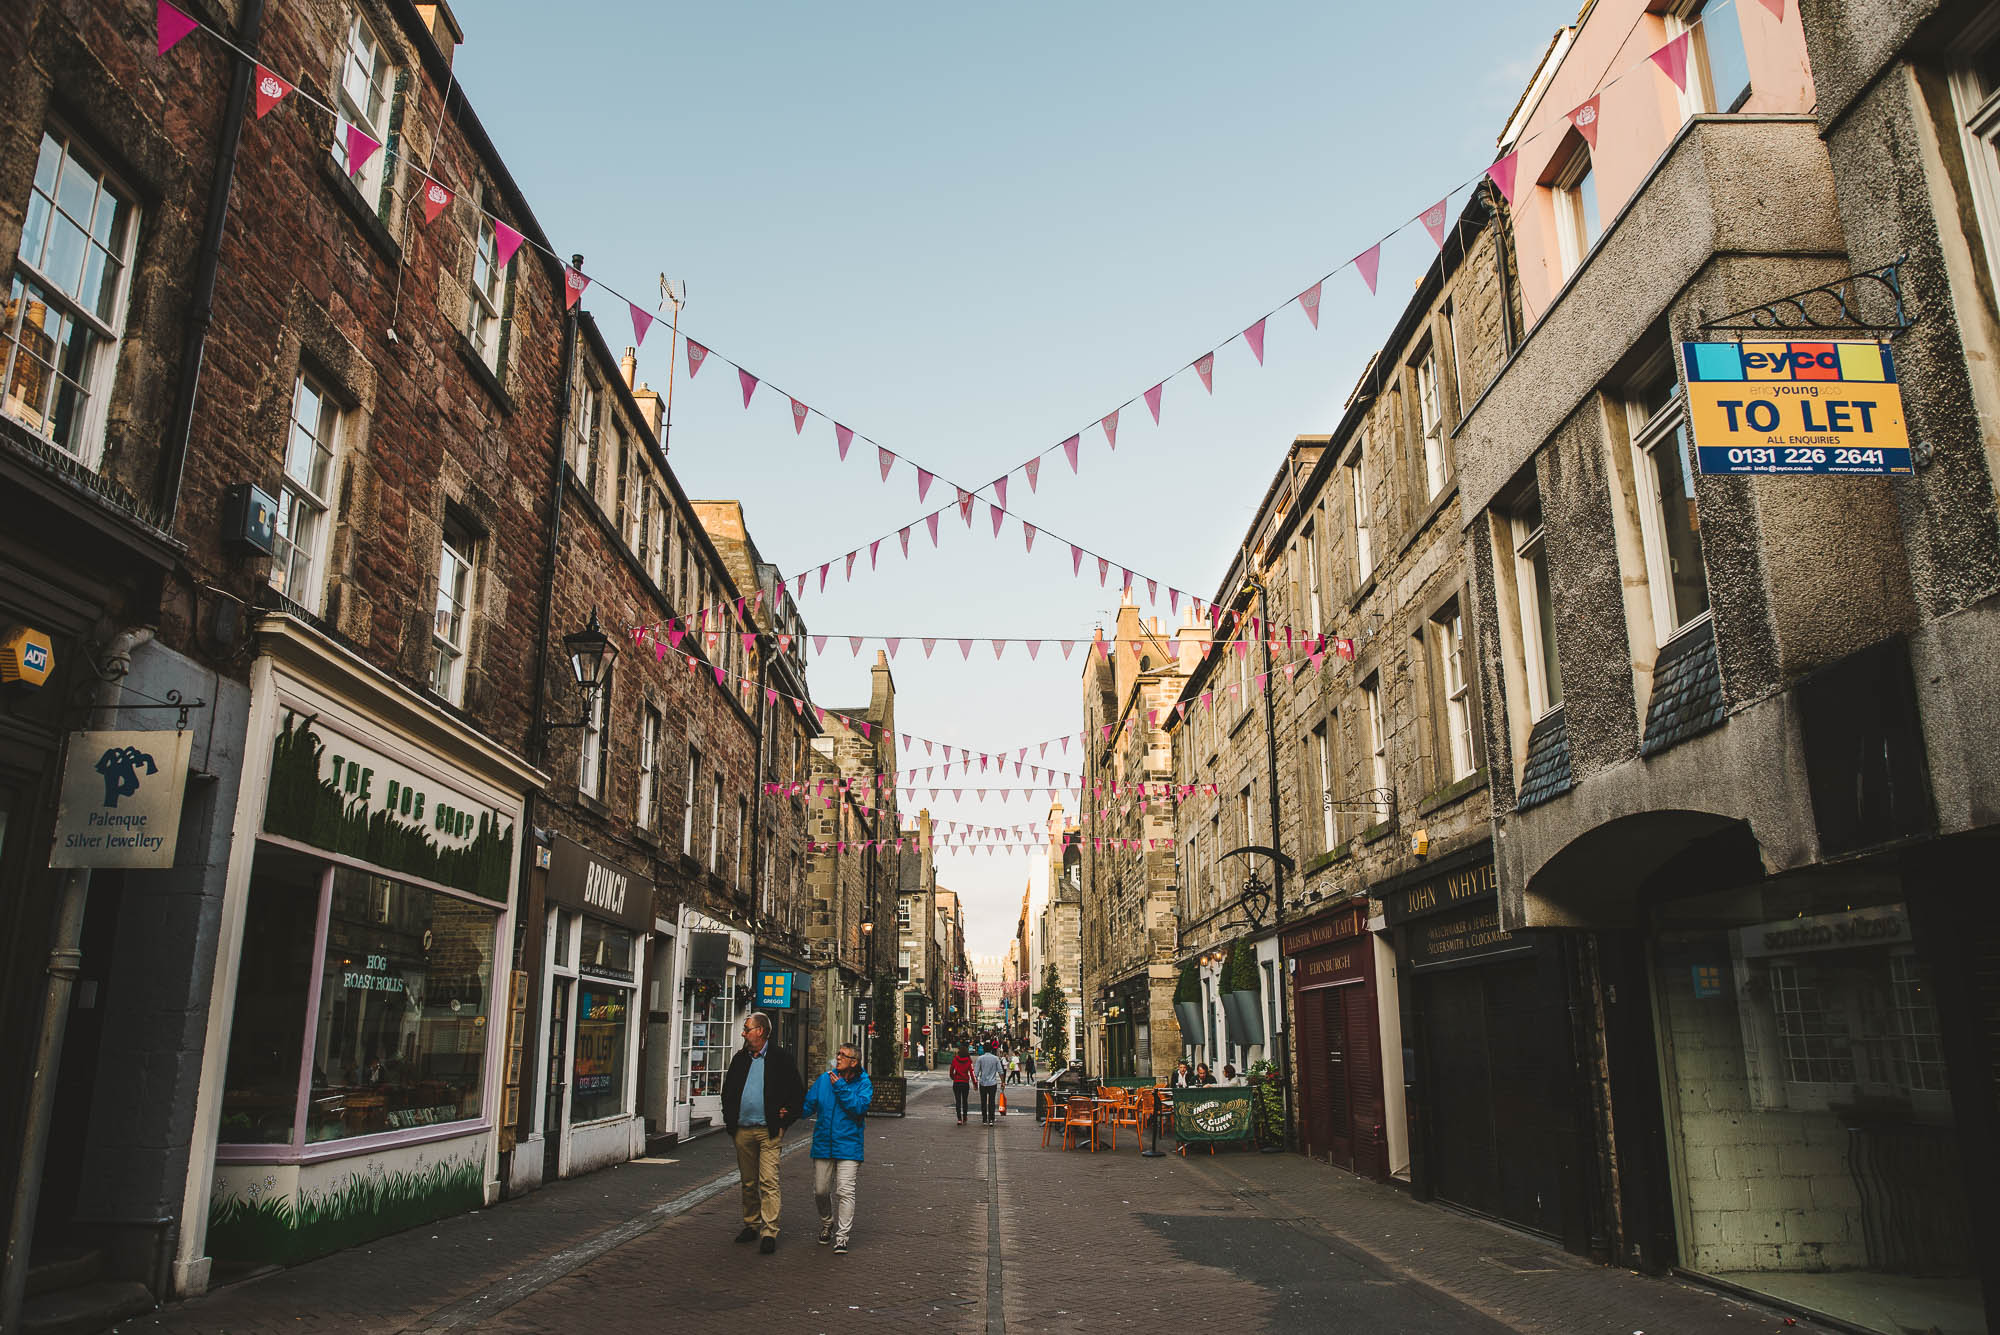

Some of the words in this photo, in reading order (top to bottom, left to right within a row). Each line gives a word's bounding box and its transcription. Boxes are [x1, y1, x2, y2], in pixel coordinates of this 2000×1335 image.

[1743, 351, 1841, 373] eyco
[1717, 400, 1780, 432] TO
[1800, 400, 1877, 433] LET
[1767, 436, 1785, 444] ALL
[1789, 435, 1840, 445] ENQUIRIES
[1728, 448, 1776, 464] 0131
[1784, 448, 1826, 464] 226
[1835, 449, 1884, 465] 2641
[24, 648, 47, 667] ADT
[332, 755, 374, 800] THE
[386, 780, 425, 821] HOG
[435, 803, 474, 840] SHOP
[88, 812, 147, 831] Palenque
[65, 833, 101, 848] Silver
[106, 833, 163, 852] Jewellery
[583, 860, 628, 915] BRUNCH
[1408, 885, 1436, 913] JOHN
[1447, 863, 1498, 900] WHYTE
[1312, 926, 1333, 943] WOOD
[1335, 916, 1352, 936] TAIT
[1427, 938, 1464, 954] SILVERSMITH
[1471, 930, 1512, 947] CLOCKMAKER
[366, 954, 387, 971] HOG
[1309, 953, 1351, 976] EDINBURGH
[343, 972, 376, 990] ROAST
[376, 975, 403, 993] ROLLS
[580, 1034, 593, 1060] TO
[597, 1034, 612, 1060] LET
[1193, 1101, 1217, 1114] INNIS
[1196, 1118, 1215, 1132] LAGER
[1216, 1122, 1230, 1132] BEER
[1208, 1112, 1233, 1126] GUNN
